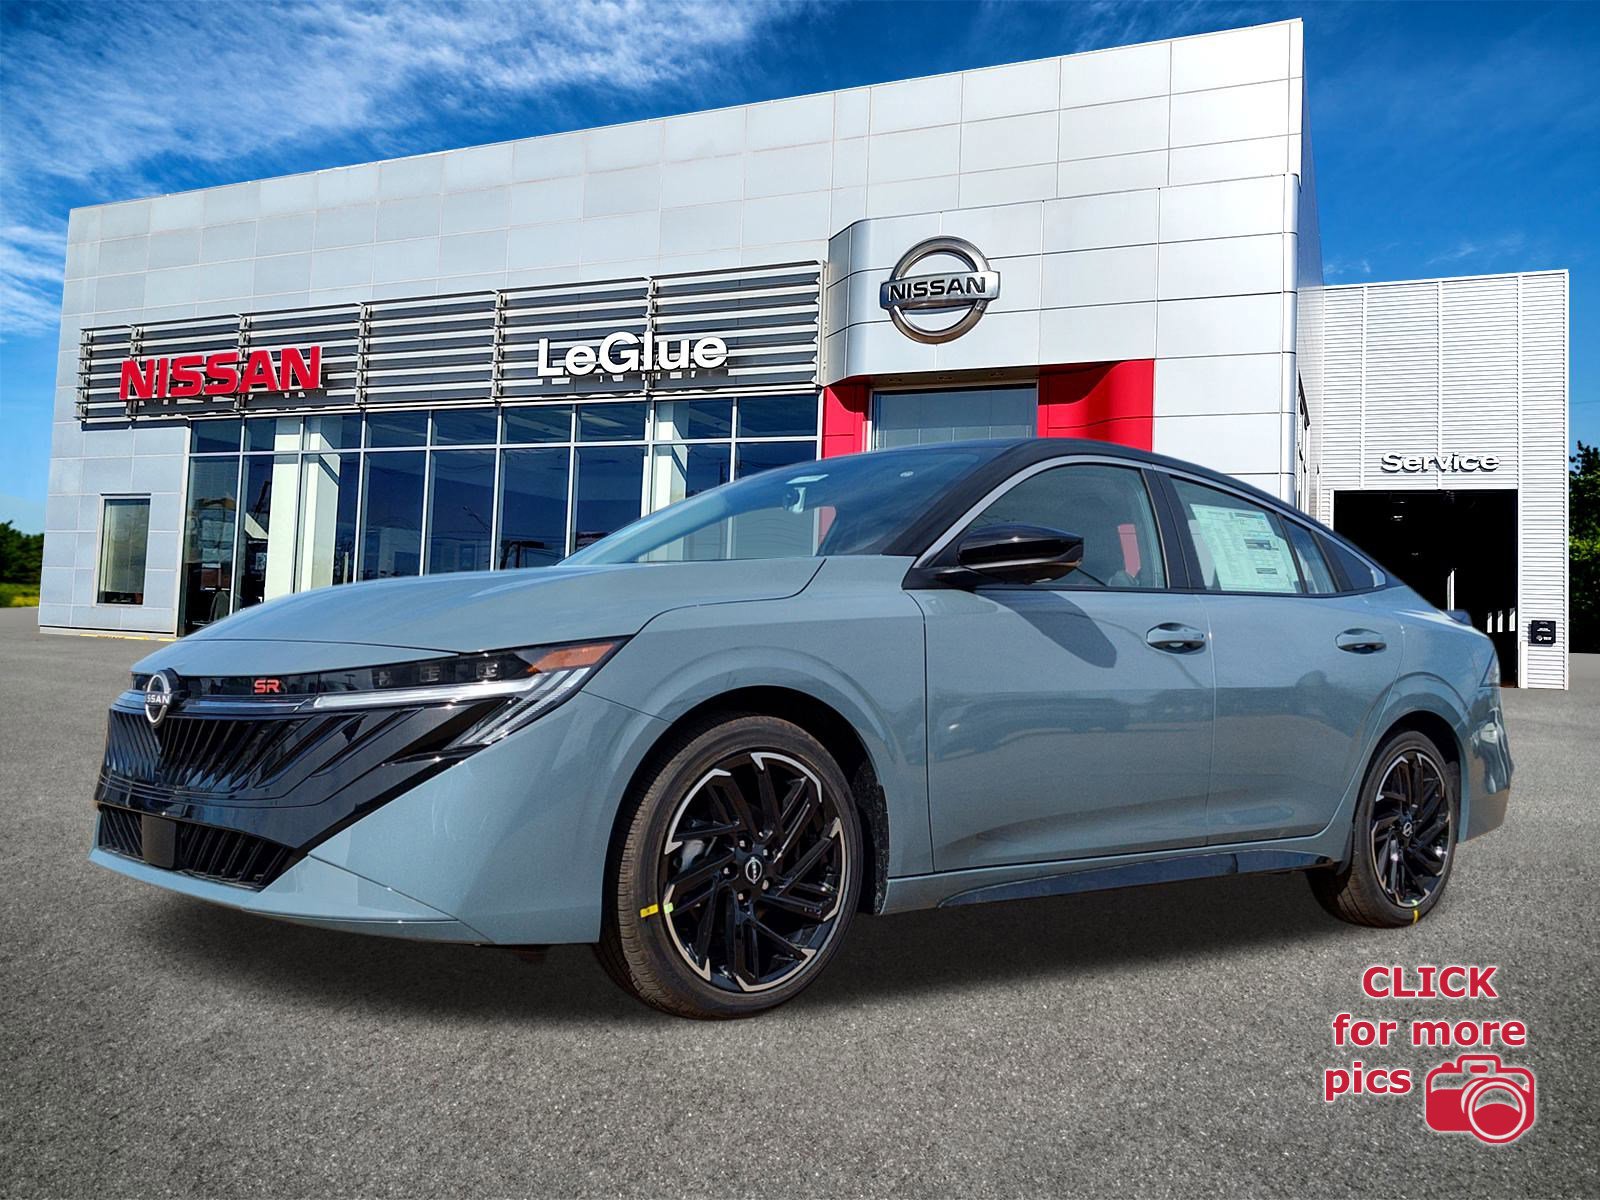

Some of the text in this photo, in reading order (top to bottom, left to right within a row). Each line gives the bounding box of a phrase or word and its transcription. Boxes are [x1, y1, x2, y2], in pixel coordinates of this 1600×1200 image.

[889, 277, 986, 301] NISSAN
[538, 331, 728, 377] LeGlue
[119, 345, 322, 400] NISSAN
[1381, 451, 1500, 473] Service
[254, 679, 280, 694] SR
